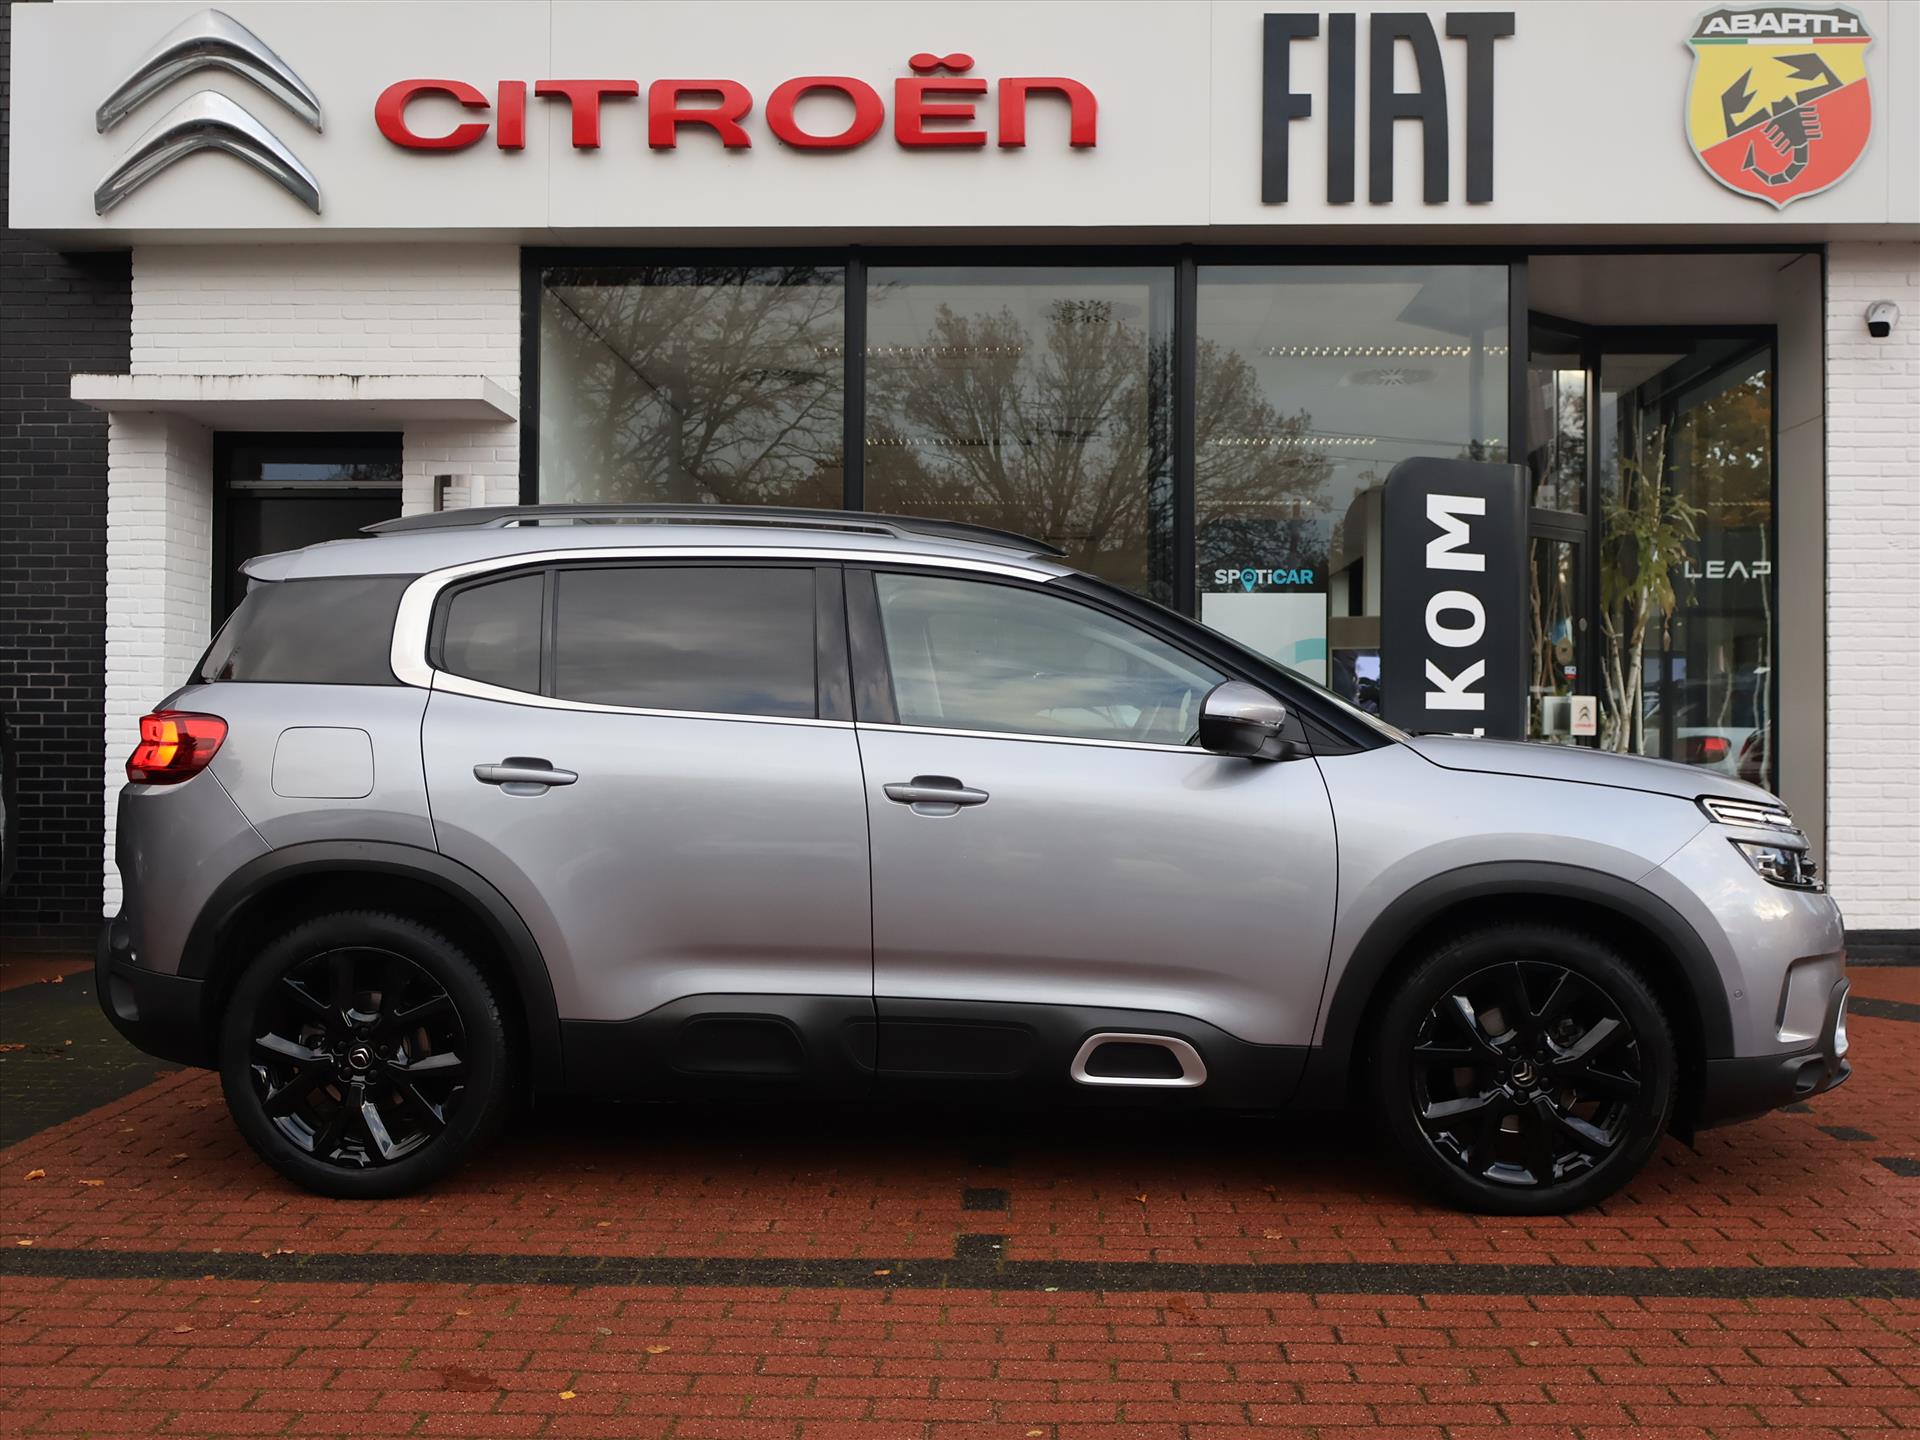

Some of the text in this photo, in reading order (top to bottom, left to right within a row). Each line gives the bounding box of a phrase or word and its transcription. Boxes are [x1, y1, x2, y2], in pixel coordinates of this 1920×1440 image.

[1702, 12, 1858, 34] ABARTH
[375, 53, 1098, 150] CITROËN
[1261, 12, 1515, 204] FIAT
[1425, 493, 1486, 737] KOM
[1684, 560, 1772, 579] LEAP
